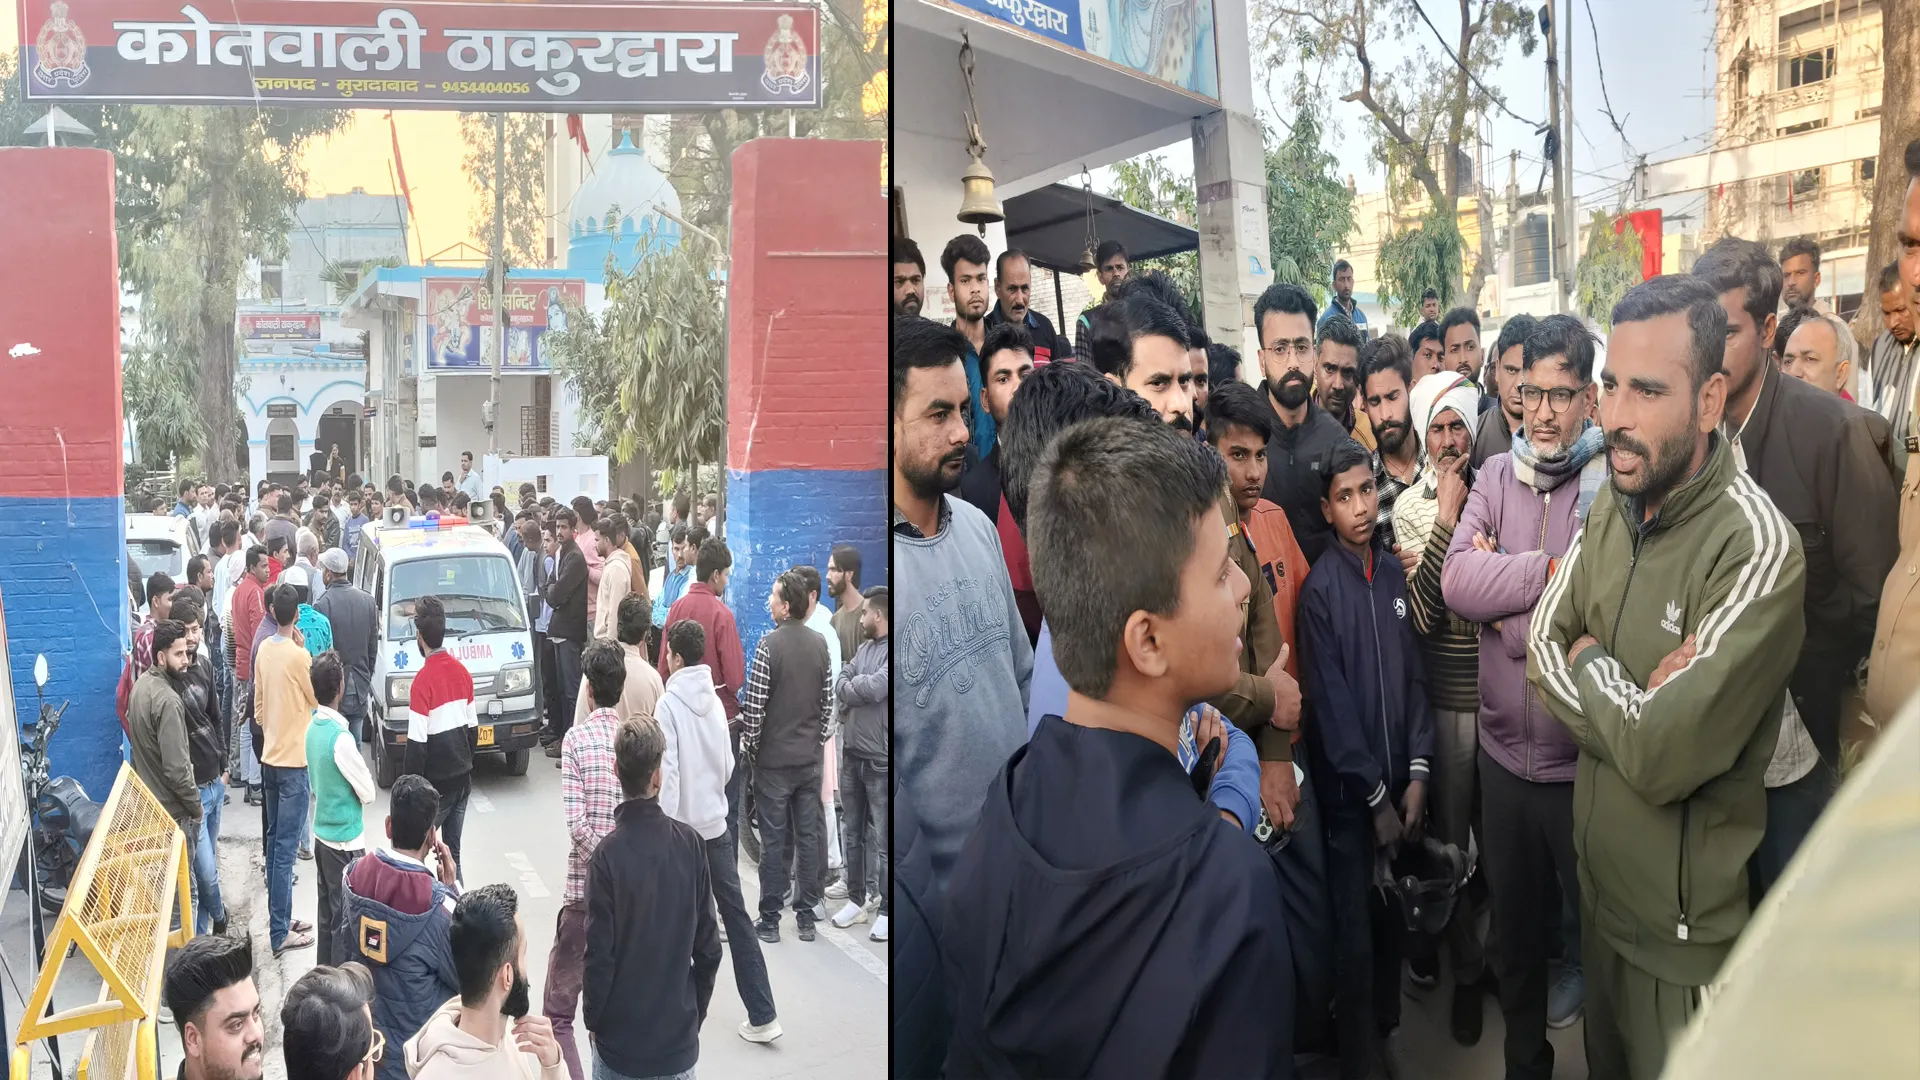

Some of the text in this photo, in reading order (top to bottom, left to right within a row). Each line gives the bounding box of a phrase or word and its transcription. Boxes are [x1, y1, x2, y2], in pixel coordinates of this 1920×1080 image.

[113, 4, 739, 96] कोतवाली ठाकुरद्वारा
[254, 78, 317, 91] जनपद
[336, 79, 419, 97] मुरादाबाद
[442, 82, 530, 93] 9454404056
[1660, 619, 1682, 636] adidas
